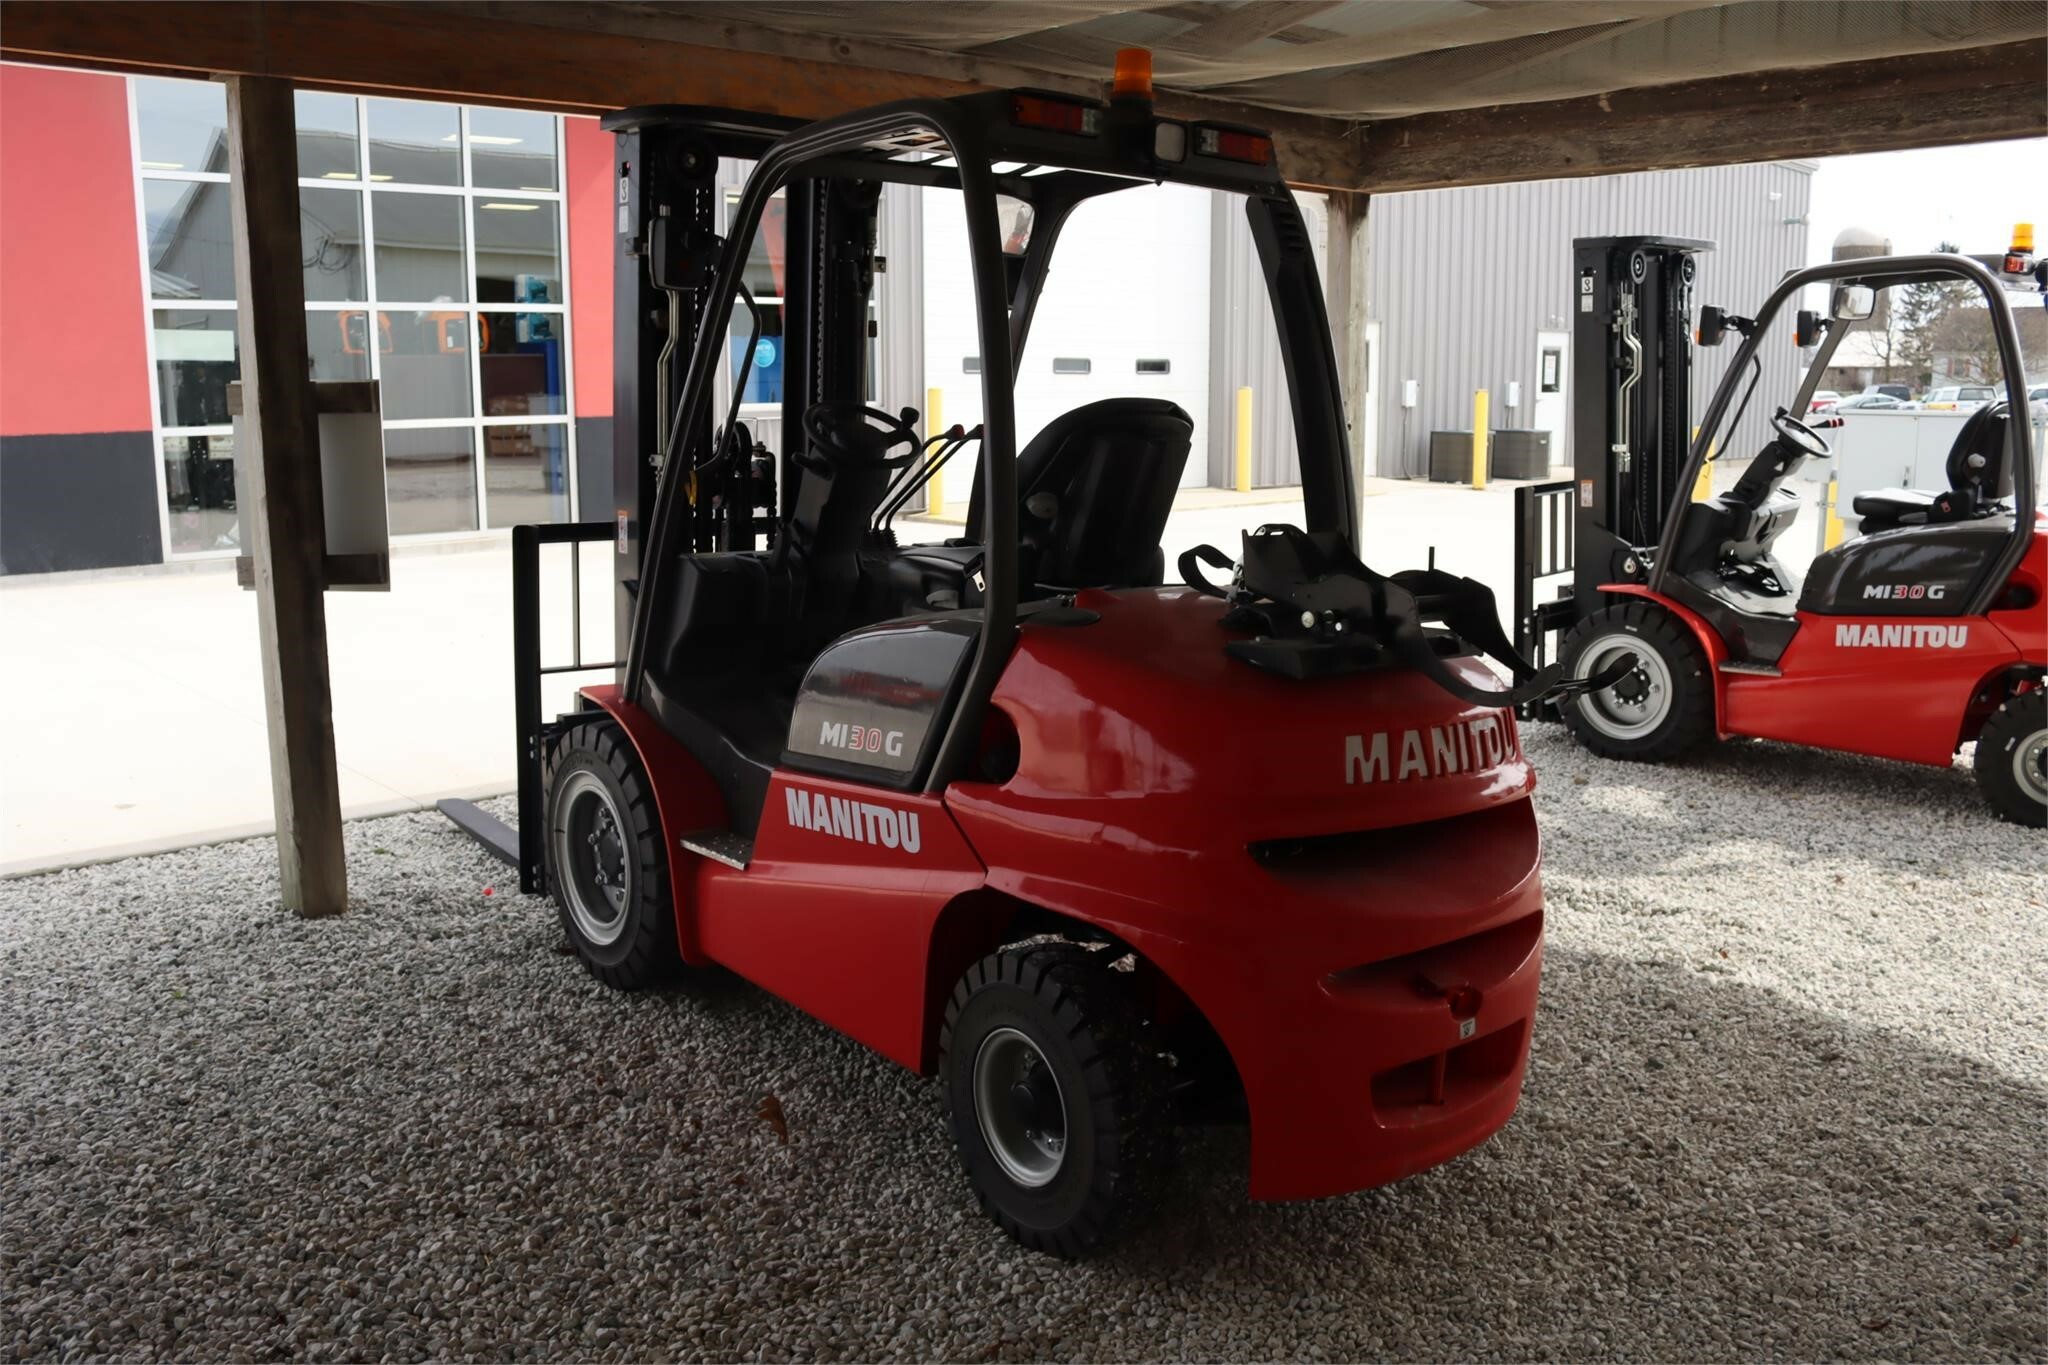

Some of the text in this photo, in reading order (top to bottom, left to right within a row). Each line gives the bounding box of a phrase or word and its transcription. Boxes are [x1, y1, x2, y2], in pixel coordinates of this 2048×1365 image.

[1835, 624, 1968, 648] MANITOU
[1345, 710, 1516, 784] MANITOU
[785, 787, 921, 854] MANITOU
